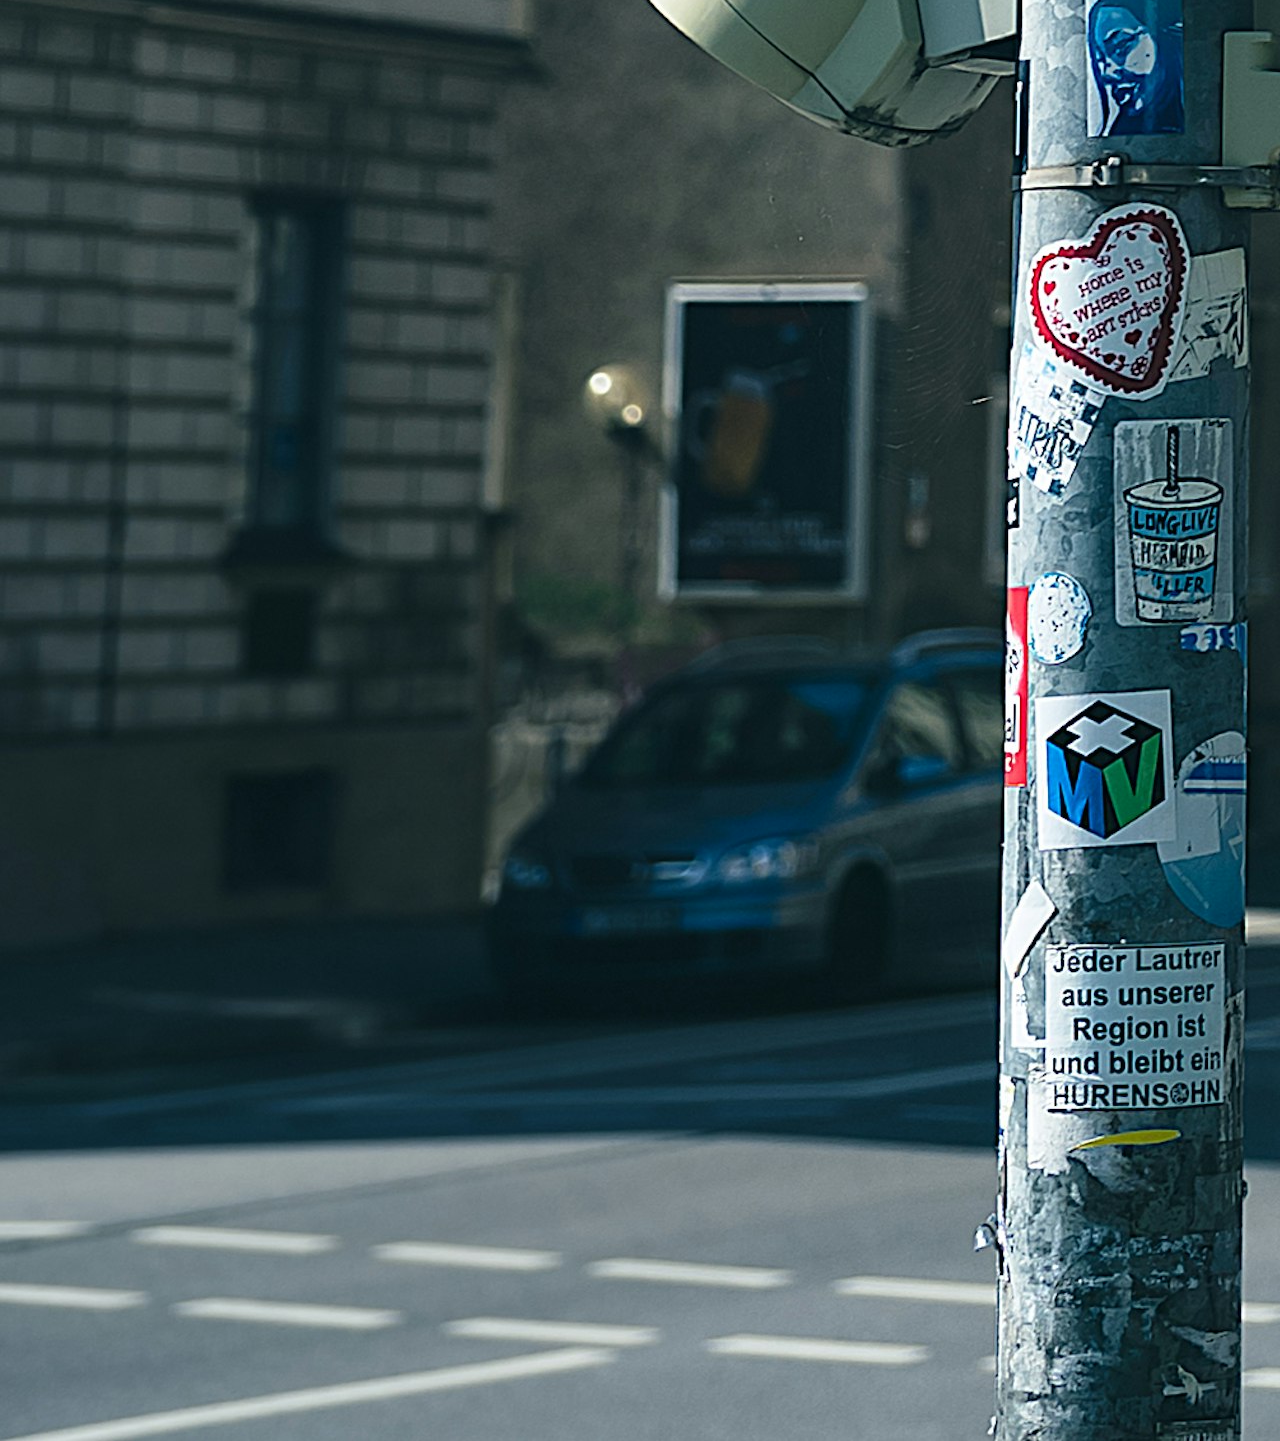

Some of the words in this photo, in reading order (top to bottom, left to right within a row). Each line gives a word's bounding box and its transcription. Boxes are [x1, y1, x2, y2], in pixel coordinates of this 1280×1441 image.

[1053, 949, 1127, 973] Jeder
[1136, 948, 1221, 971] Lautrer
[1062, 987, 1108, 1007] aus
[1118, 983, 1215, 1006] unserer
[1073, 1016, 1168, 1046] Region
[1177, 1013, 1206, 1038] ist
[1052, 1051, 1099, 1075] und
[1109, 1048, 1184, 1074] bleibt
[1191, 1046, 1221, 1071] ein
